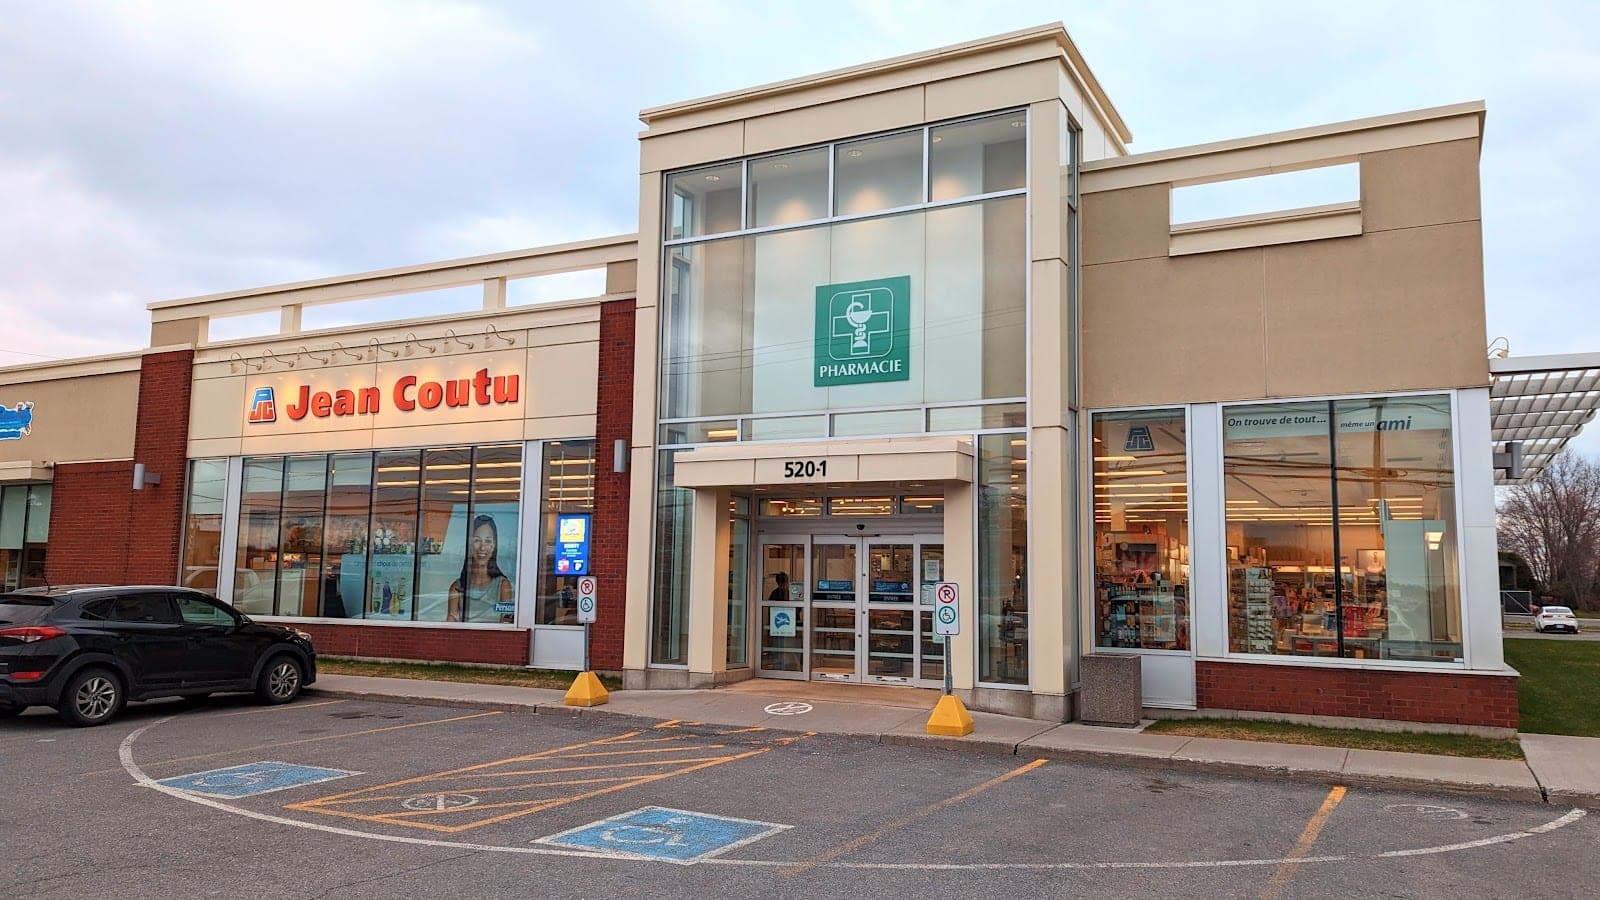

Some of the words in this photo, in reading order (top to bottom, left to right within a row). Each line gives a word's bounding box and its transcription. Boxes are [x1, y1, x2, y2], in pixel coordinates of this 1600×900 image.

[819, 359, 902, 378] PHARMACIE
[286, 384, 381, 421] Jean
[393, 368, 520, 412] Coutu
[1227, 418, 1242, 428] On
[1244, 416, 1278, 427] trouve
[1279, 415, 1292, 425] de
[1340, 420, 1364, 429] même
[1364, 420, 1376, 428] un
[1376, 415, 1413, 431] ami
